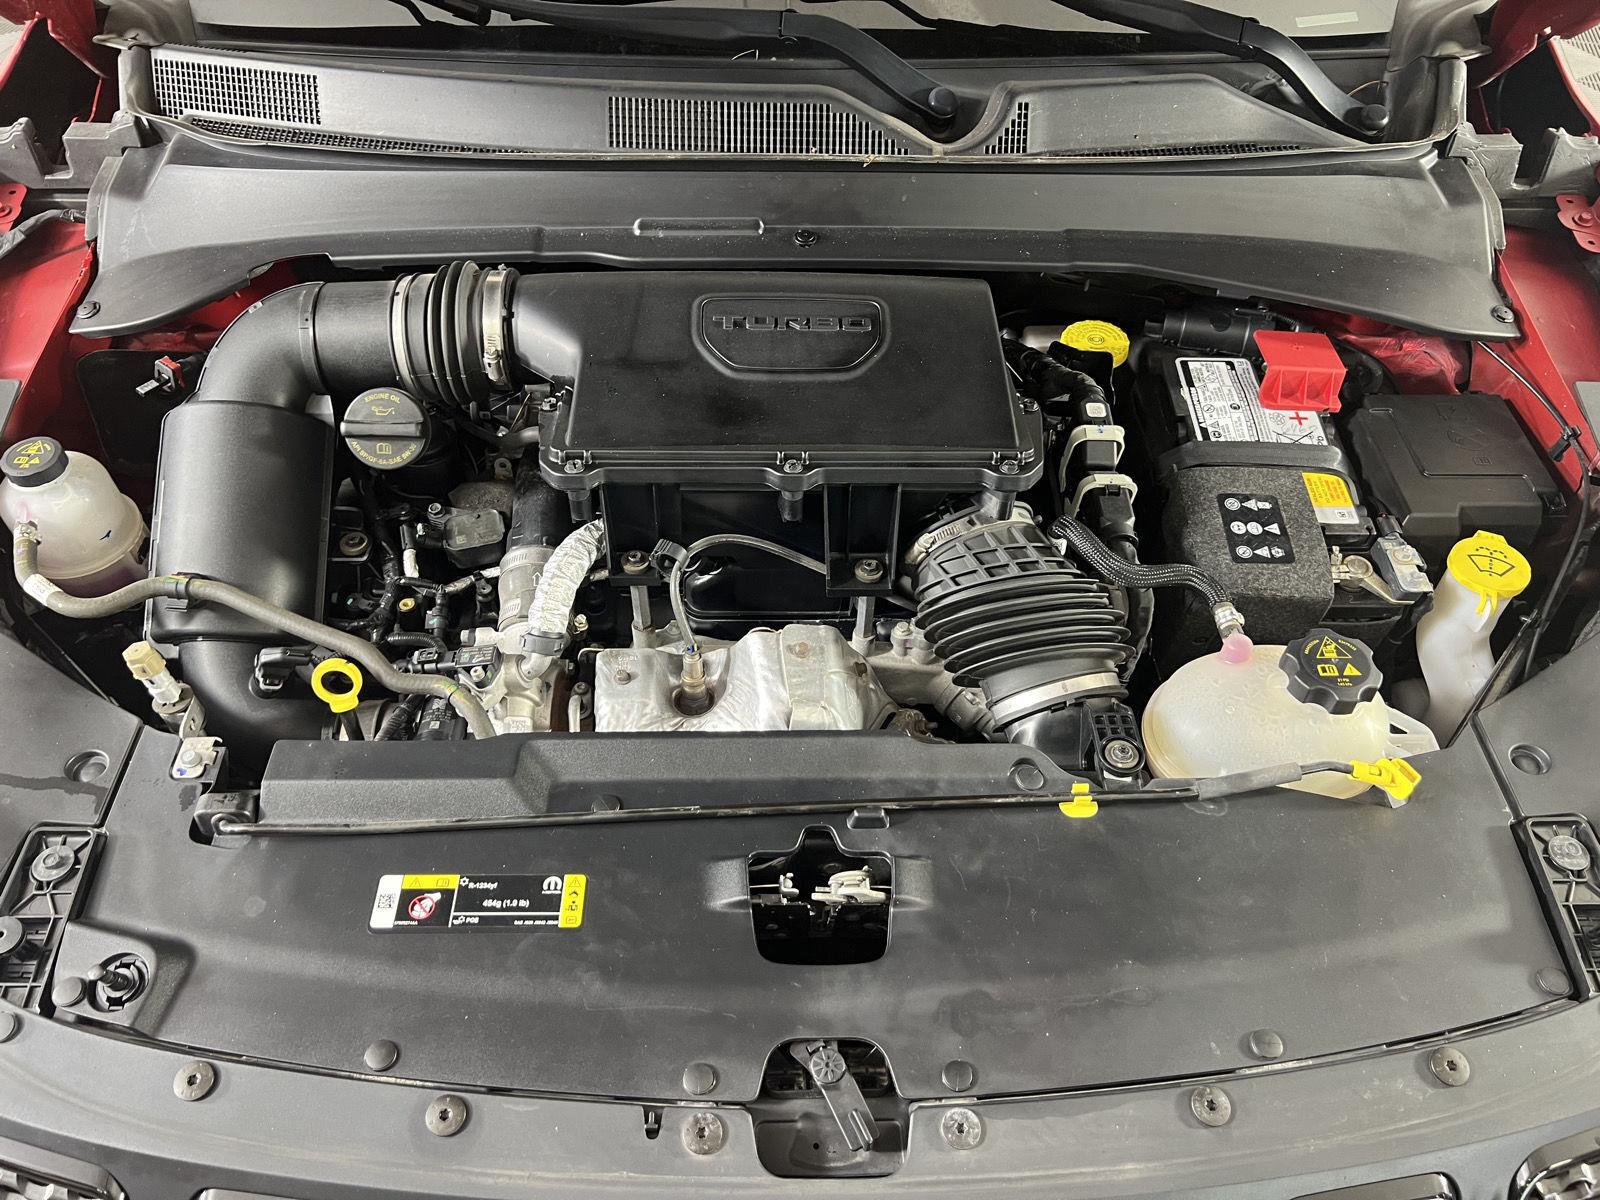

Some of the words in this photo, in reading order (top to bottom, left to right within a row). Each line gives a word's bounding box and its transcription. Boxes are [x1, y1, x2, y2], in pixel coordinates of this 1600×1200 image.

[713, 316, 872, 331] TURBO
[364, 393, 390, 403] ENGINE
[390, 394, 401, 404] OIL
[468, 881, 498, 890] R-1234yf
[482, 898, 502, 908] 454g
